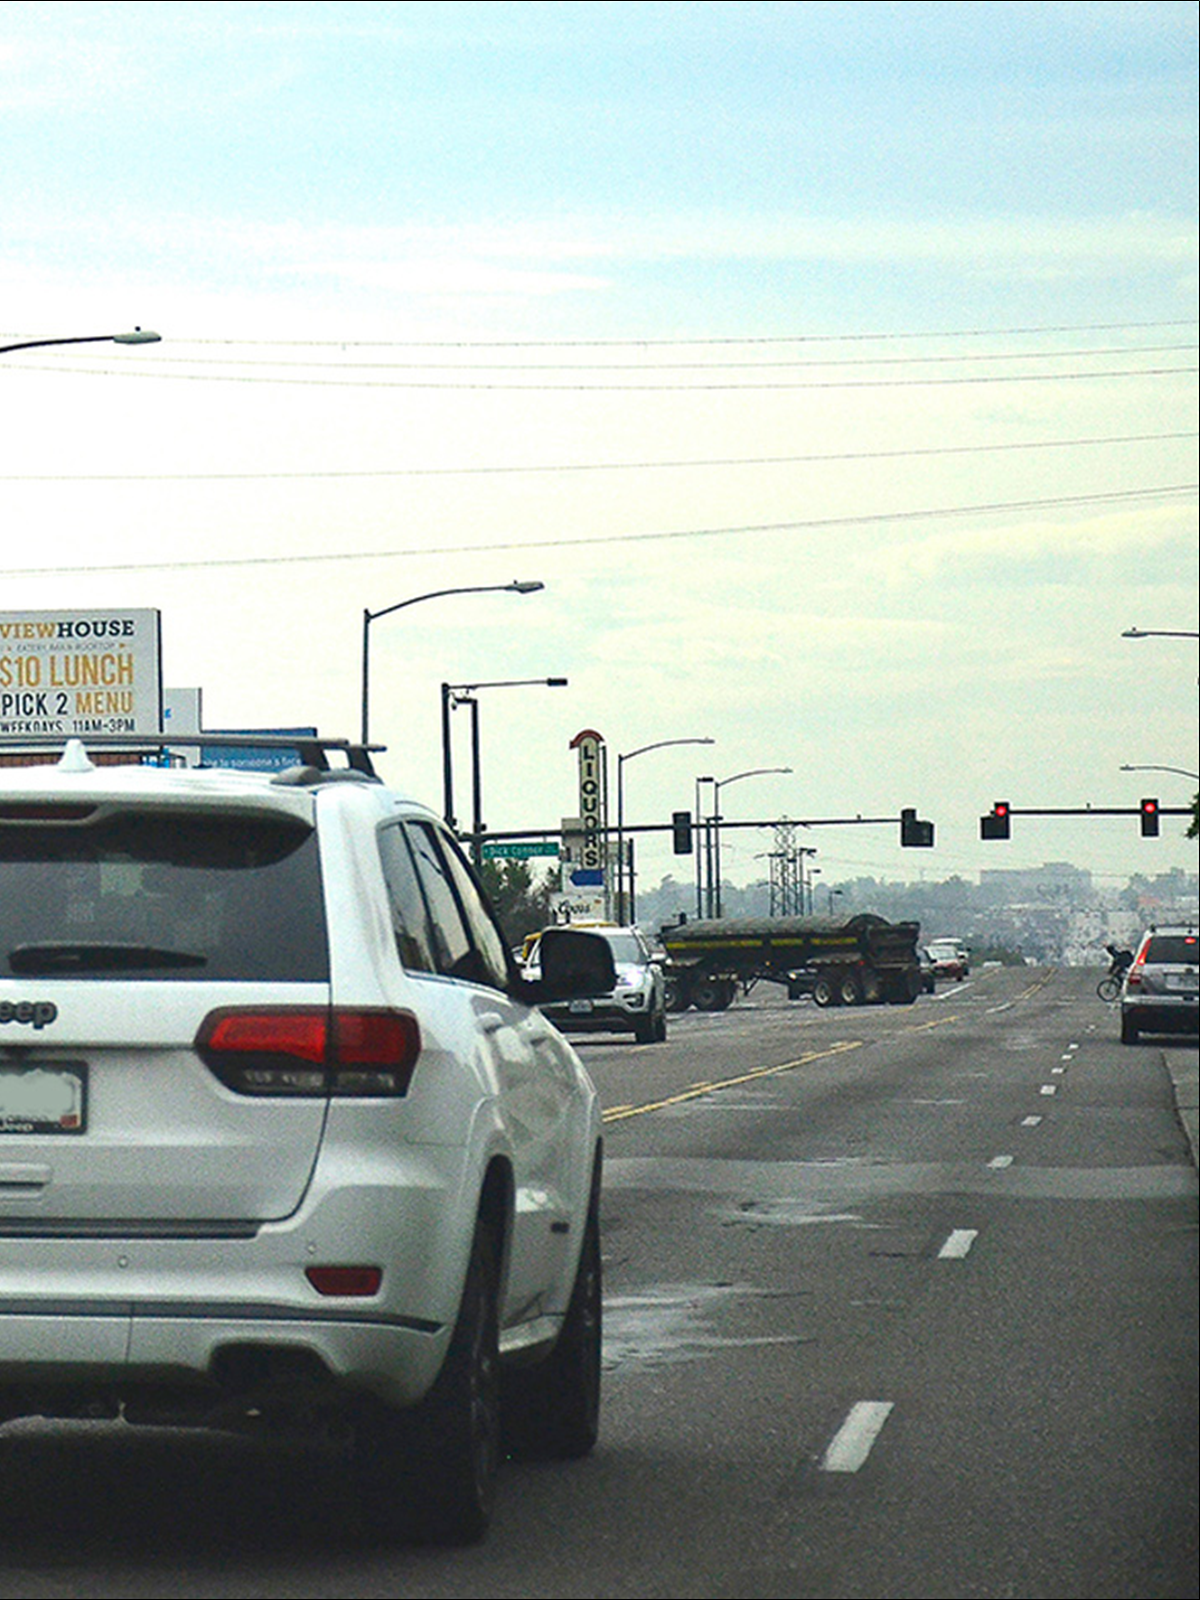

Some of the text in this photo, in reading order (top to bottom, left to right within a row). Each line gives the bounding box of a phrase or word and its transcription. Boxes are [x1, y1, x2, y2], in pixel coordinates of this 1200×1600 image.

[49, 653, 134, 686] LUNCH
[1, 691, 134, 716] PICK 2 MENU
[0, 718, 136, 733] WEEKDAYS 11AM-3PM
[582, 745, 599, 867] LIQUORS
